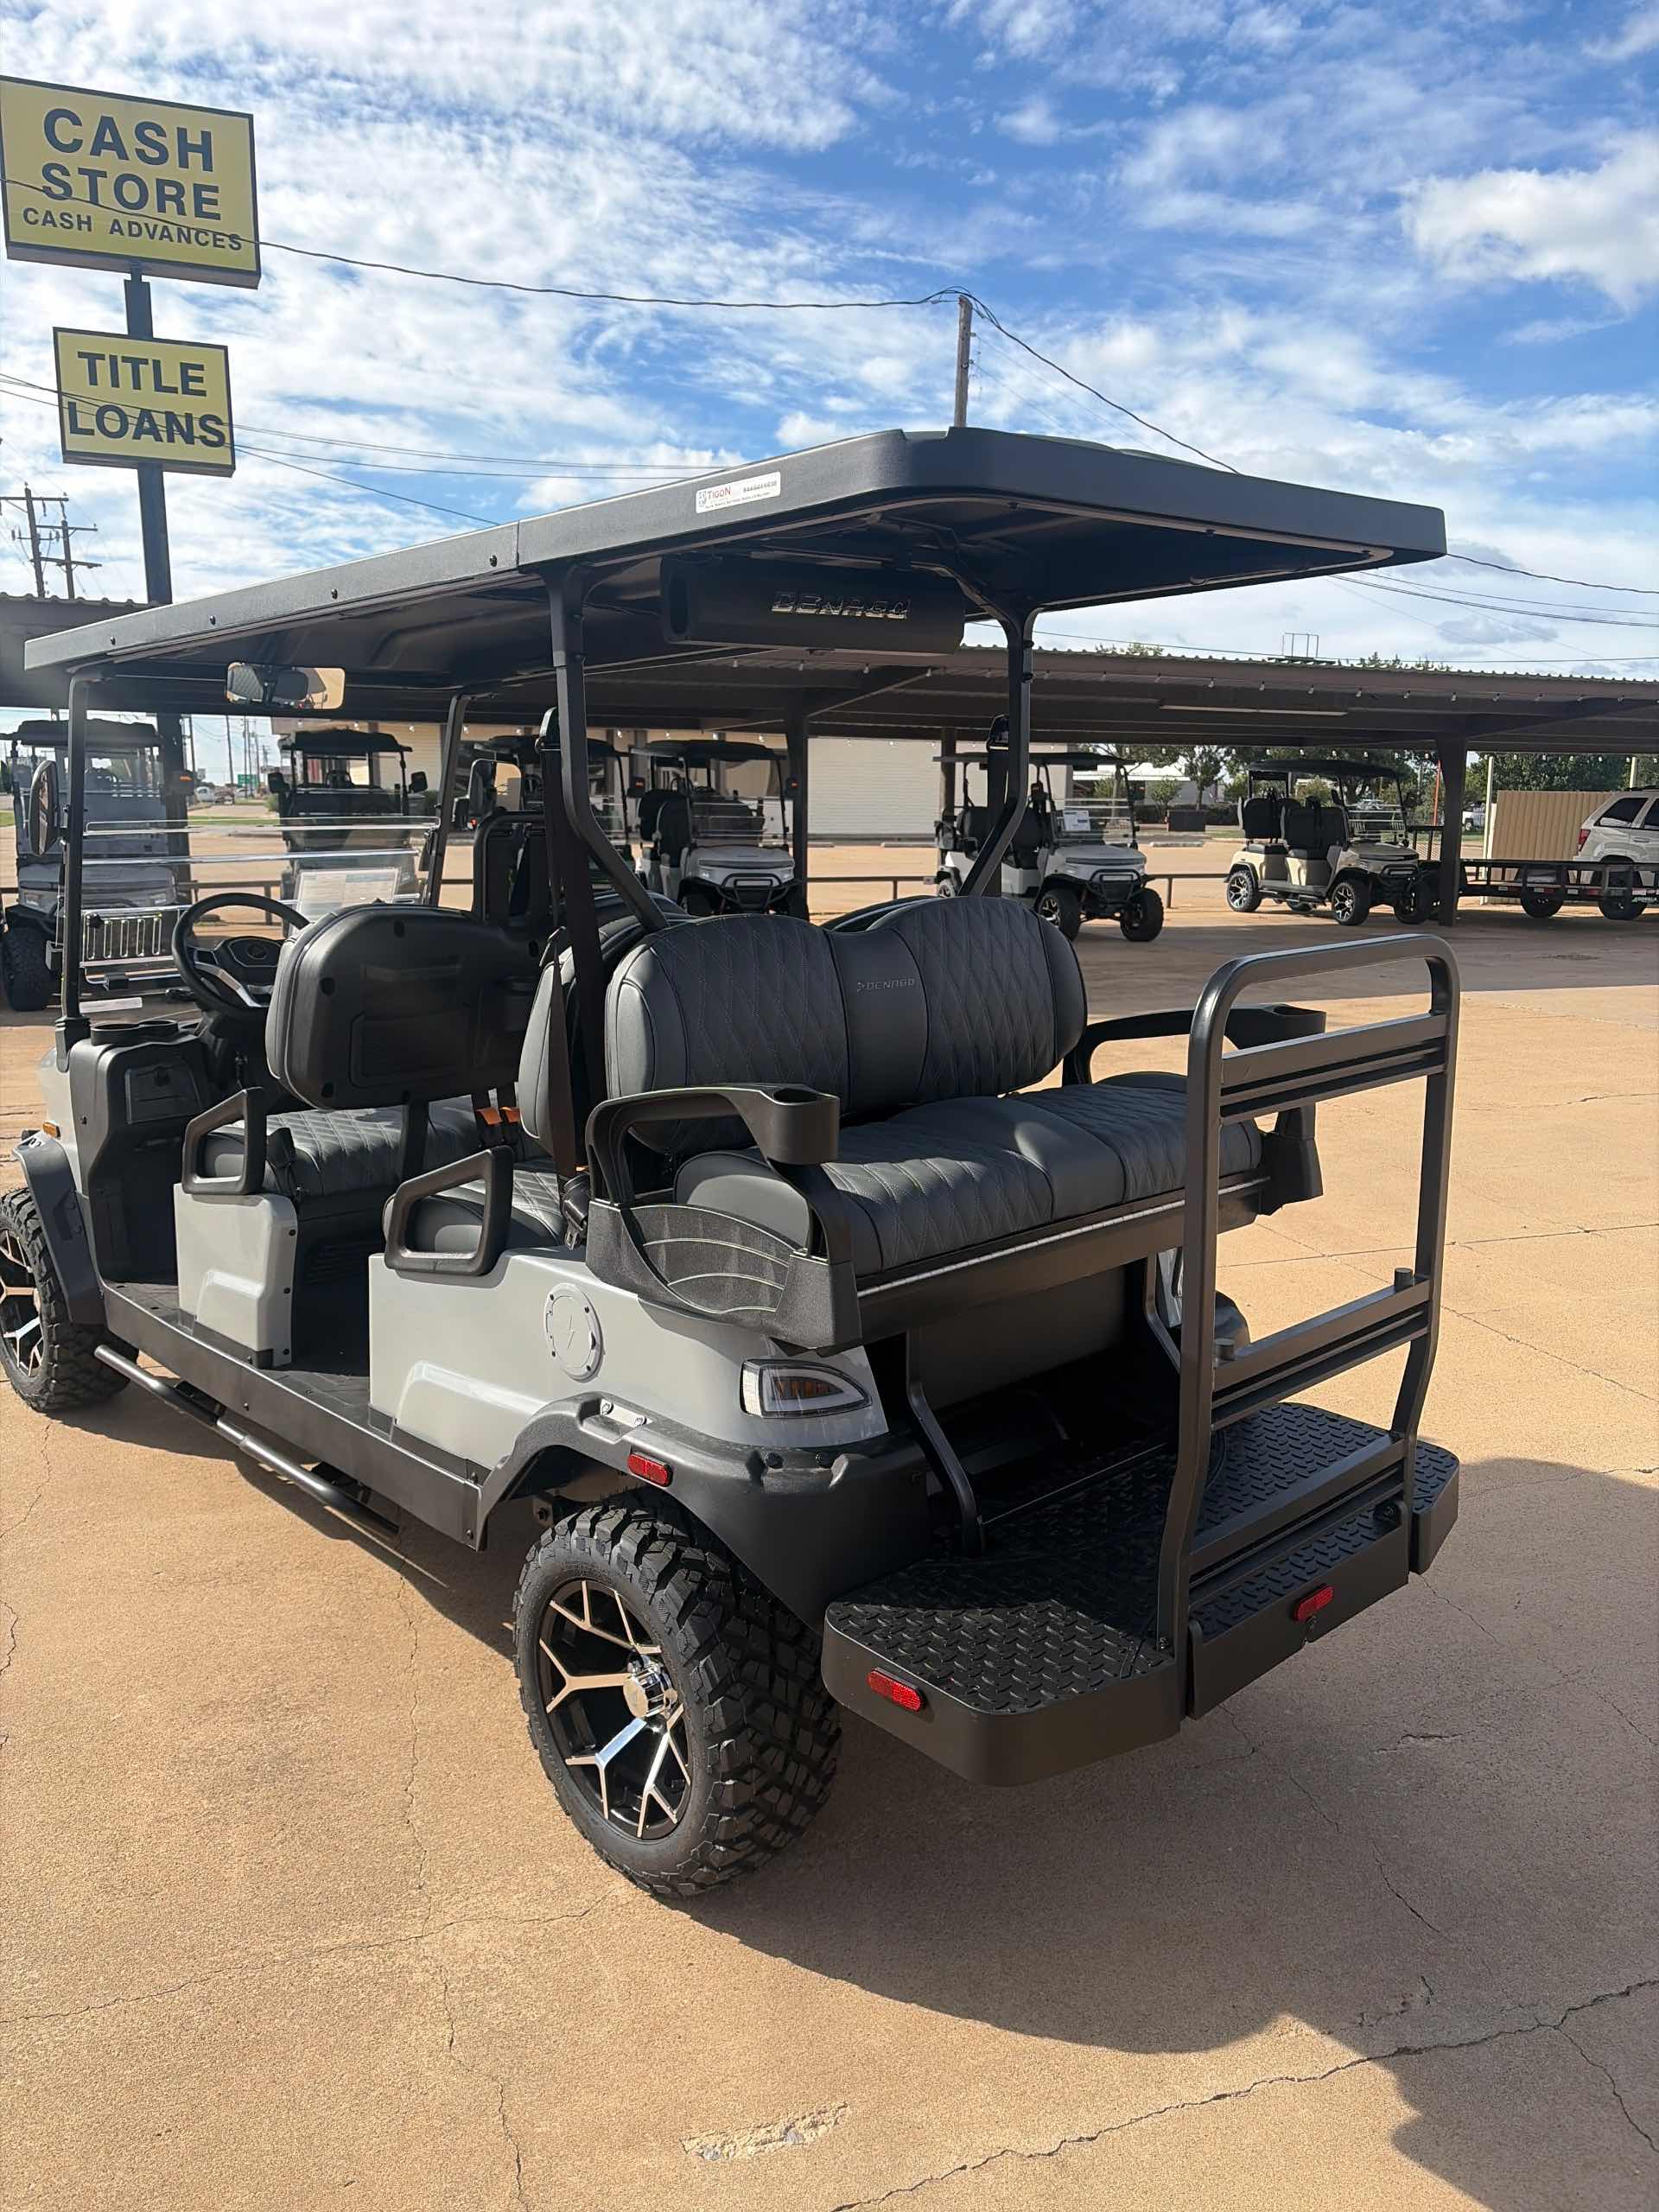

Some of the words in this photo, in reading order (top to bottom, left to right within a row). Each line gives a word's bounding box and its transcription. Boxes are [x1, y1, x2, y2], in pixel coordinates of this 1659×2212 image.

[43, 108, 214, 173] CASH
[41, 162, 222, 221] STORE
[22, 207, 92, 232] CASH
[109, 219, 243, 251] ADVANCES
[77, 351, 207, 397] TITLE
[67, 401, 226, 448] LOANS
